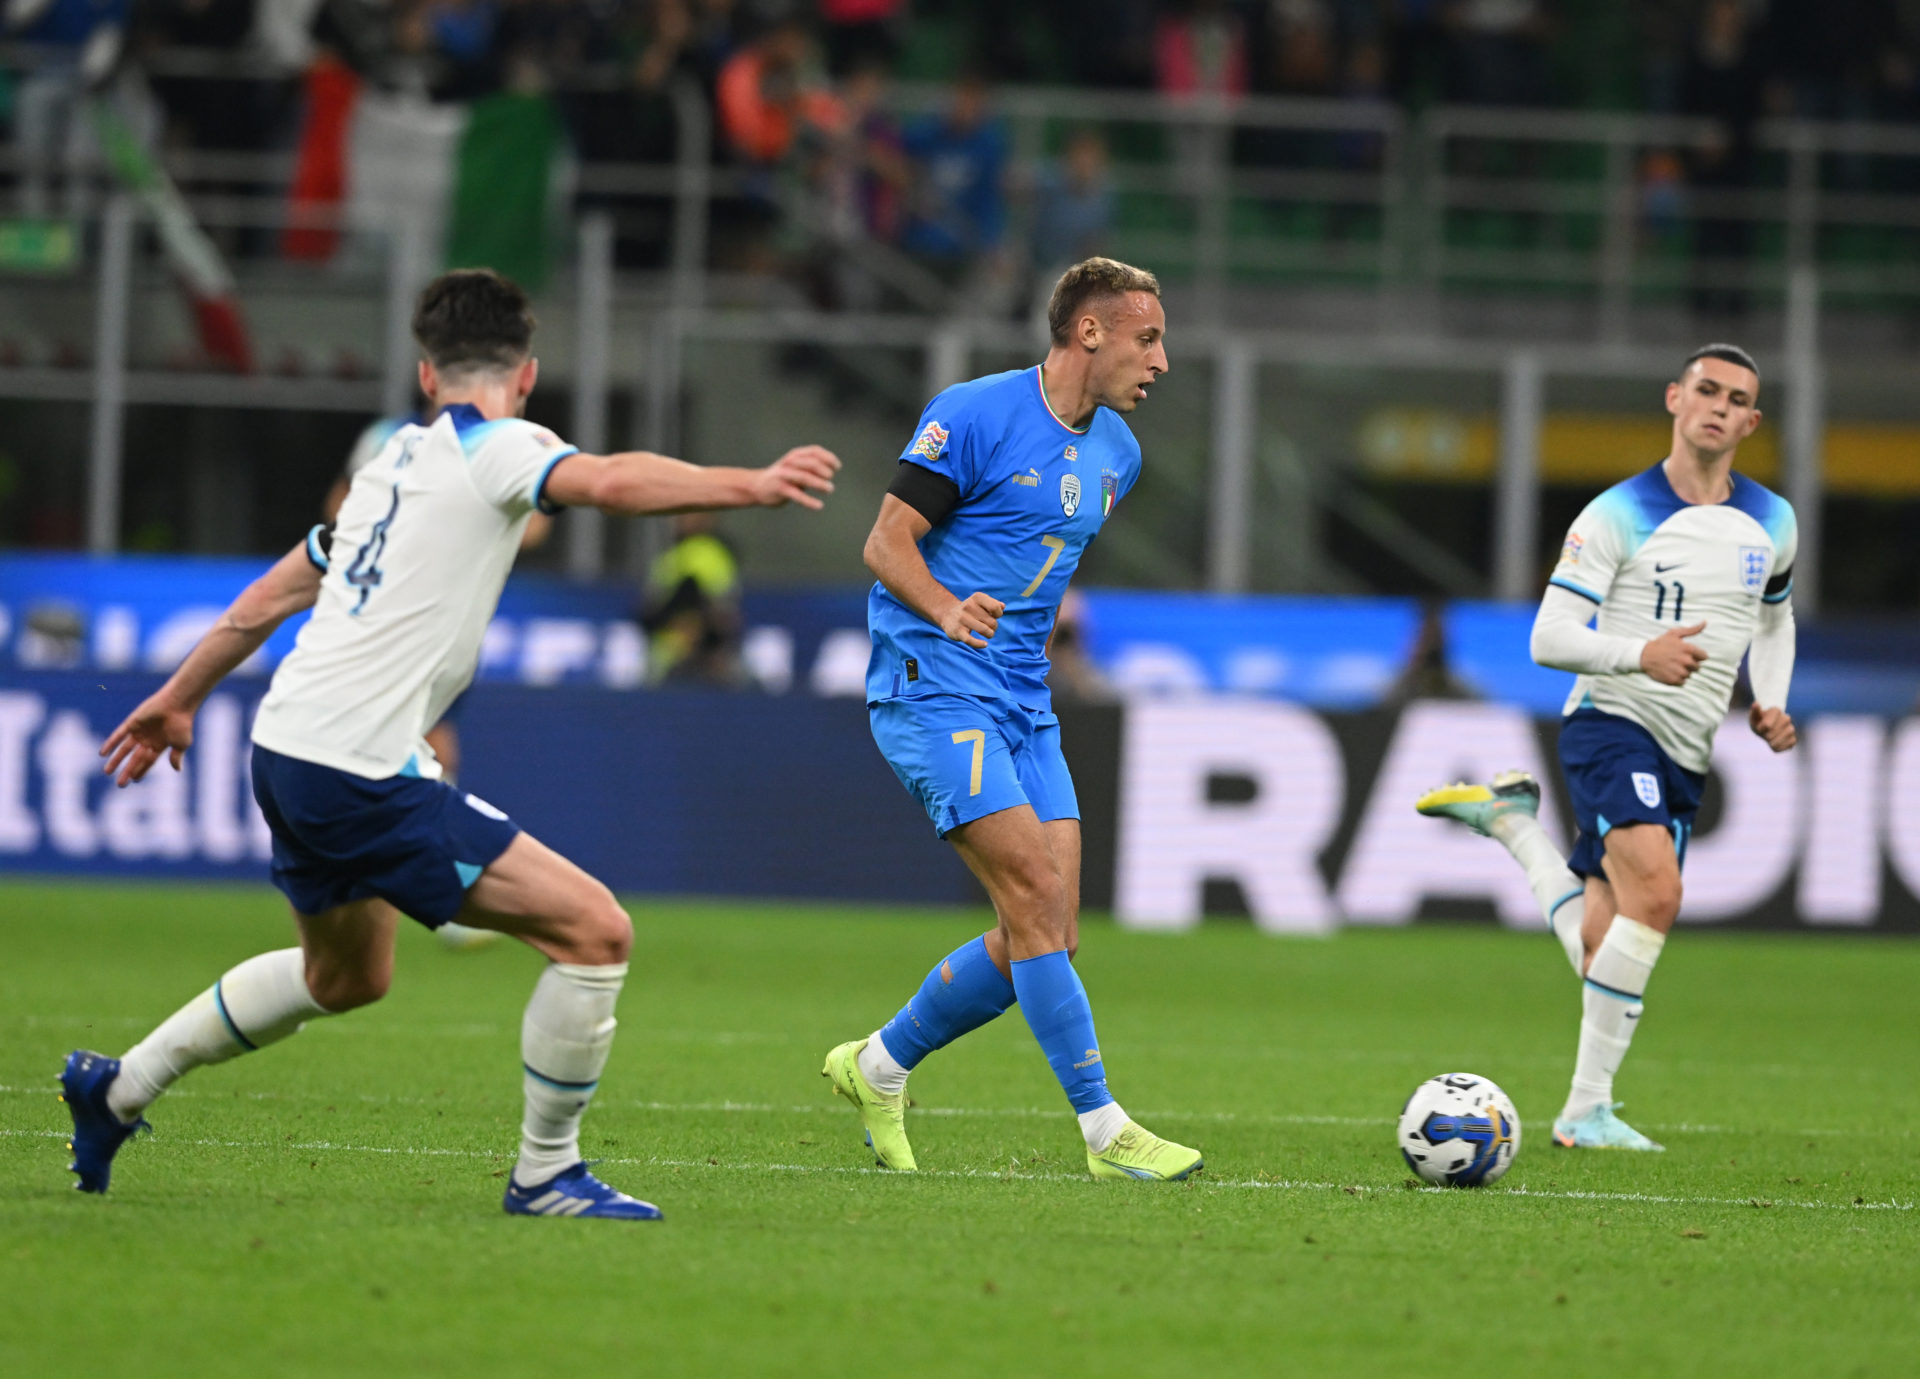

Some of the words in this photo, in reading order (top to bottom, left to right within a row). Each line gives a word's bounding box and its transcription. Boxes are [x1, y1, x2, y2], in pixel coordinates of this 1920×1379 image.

[344, 481, 401, 616] 4
[1020, 534, 1066, 598] 7
[1654, 580, 1684, 622] 11
[0, 691, 273, 862] Ital
[951, 728, 985, 797] 7
[1111, 698, 1920, 932] RADI
[1672, 818, 1692, 858] 1
